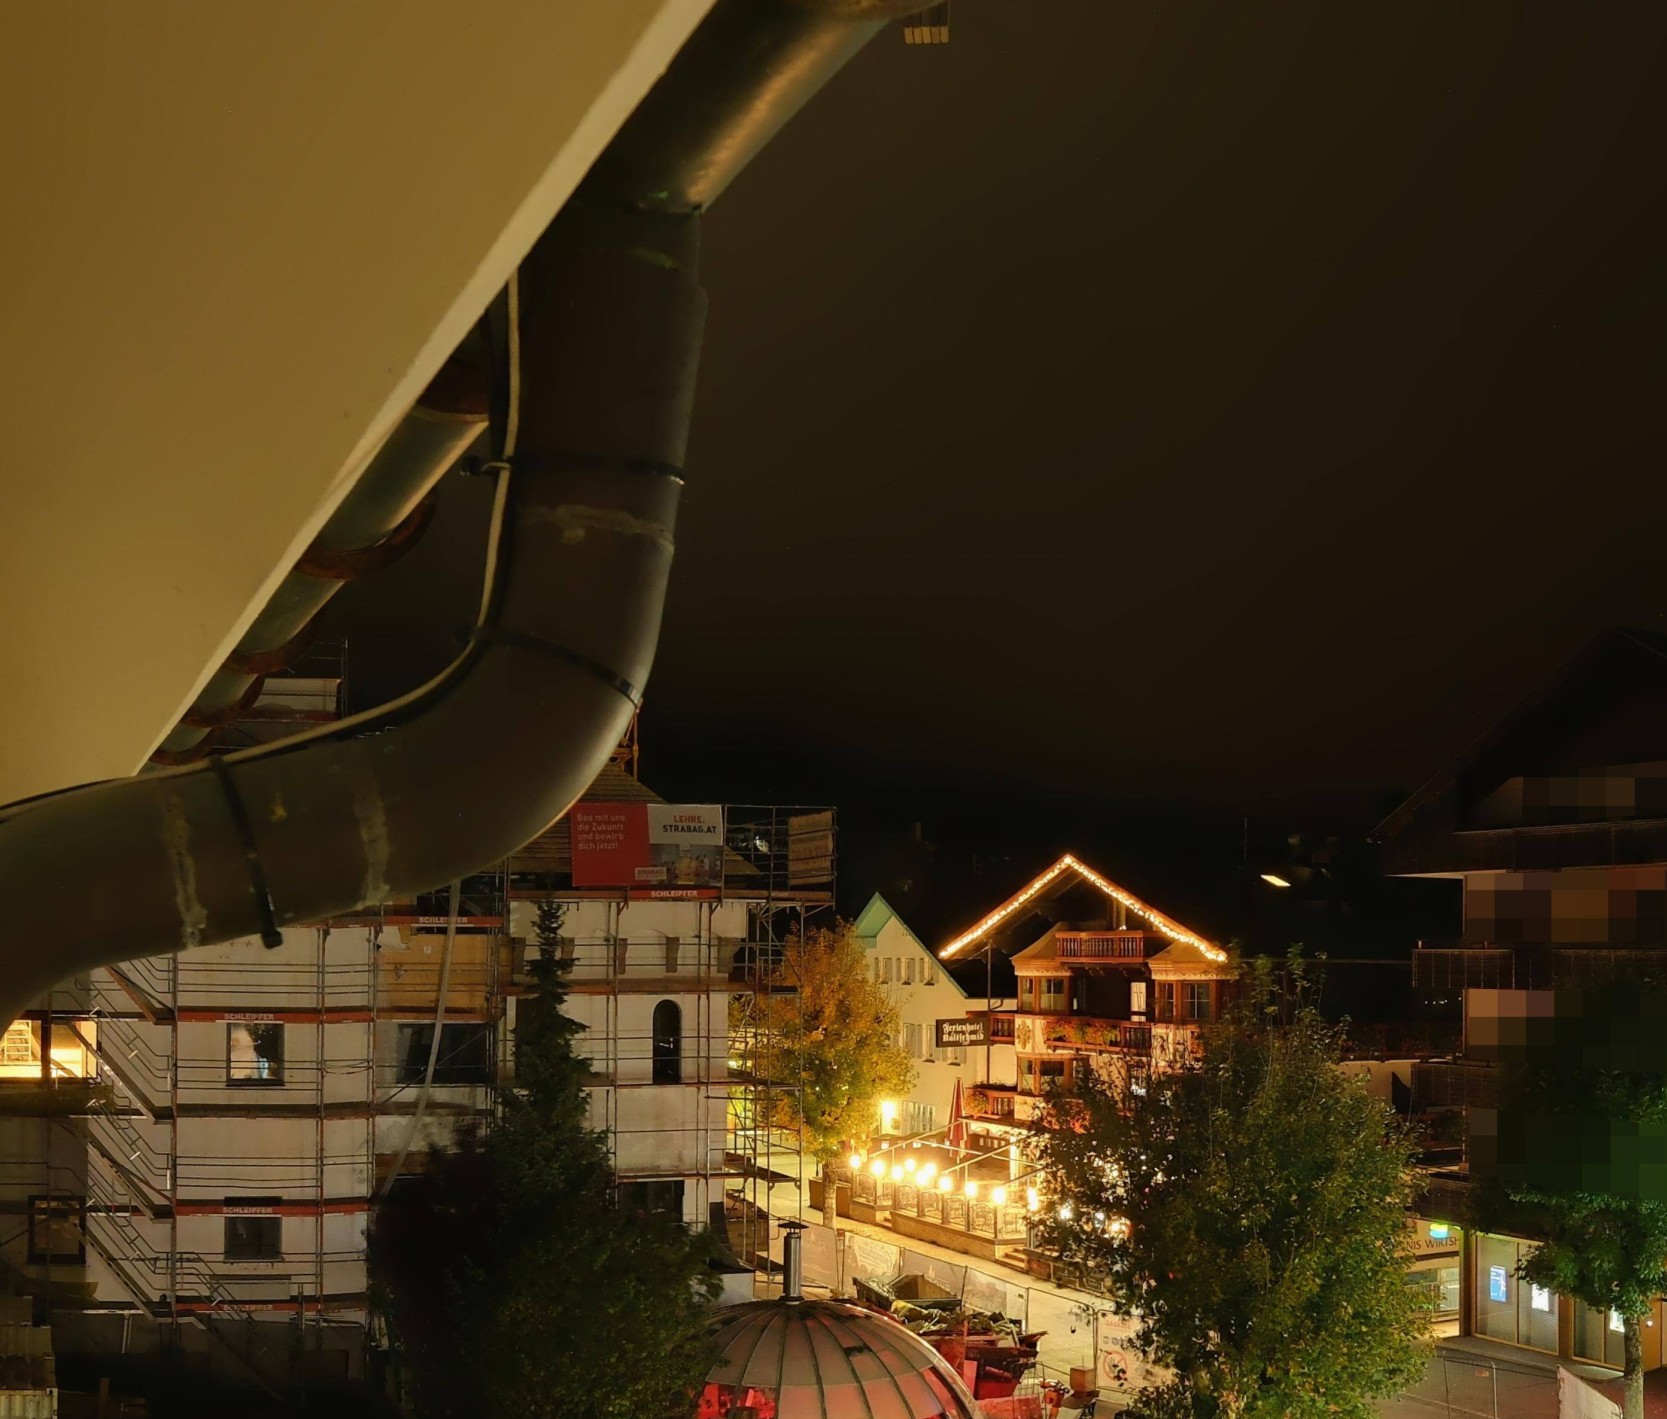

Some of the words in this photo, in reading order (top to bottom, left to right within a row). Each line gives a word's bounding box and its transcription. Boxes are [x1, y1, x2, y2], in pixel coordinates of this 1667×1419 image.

[577, 814, 595, 822] Bau
[596, 814, 608, 822] mit
[673, 815, 705, 824] LEHRE.
[577, 823, 590, 831] die
[591, 823, 624, 832] Zukunft
[662, 824, 717, 834] STRABAG.AT
[577, 832, 592, 841] und
[594, 832, 624, 841] bewirb
[577, 841, 594, 850] dich
[596, 841, 618, 852] jetzt!
